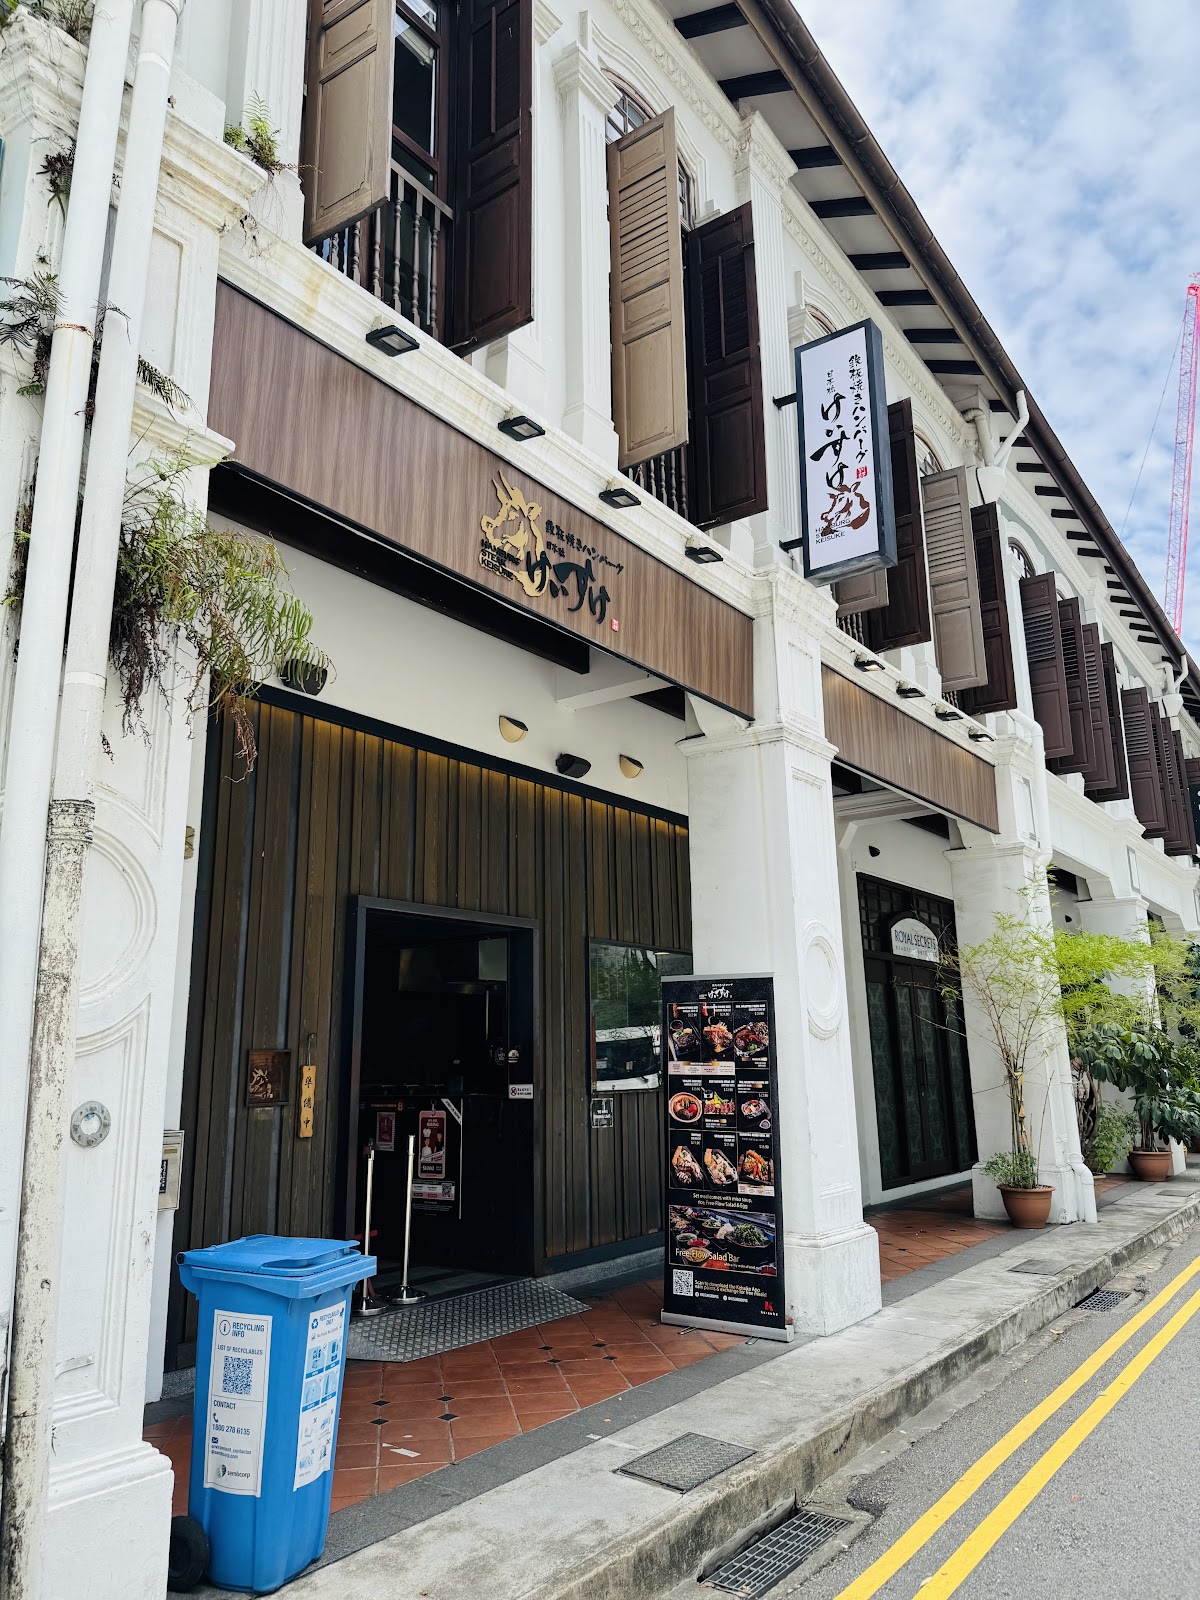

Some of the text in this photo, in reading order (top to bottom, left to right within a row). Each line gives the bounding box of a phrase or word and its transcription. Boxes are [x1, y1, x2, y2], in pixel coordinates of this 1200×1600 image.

[815, 530, 846, 545] KEISUKE
[894, 930, 914, 945] ROYAL
[708, 1251, 727, 1261] Salad
[728, 1253, 740, 1262] Bar
[232, 1321, 265, 1332] RECYCLING
[231, 1329, 245, 1338] INFO
[232, 1346, 263, 1356] RECYCLABLES
[213, 1399, 236, 1410] CONTACT
[212, 1423, 251, 1436] 1800 278 6135
[227, 1470, 251, 1479] sembcorp
